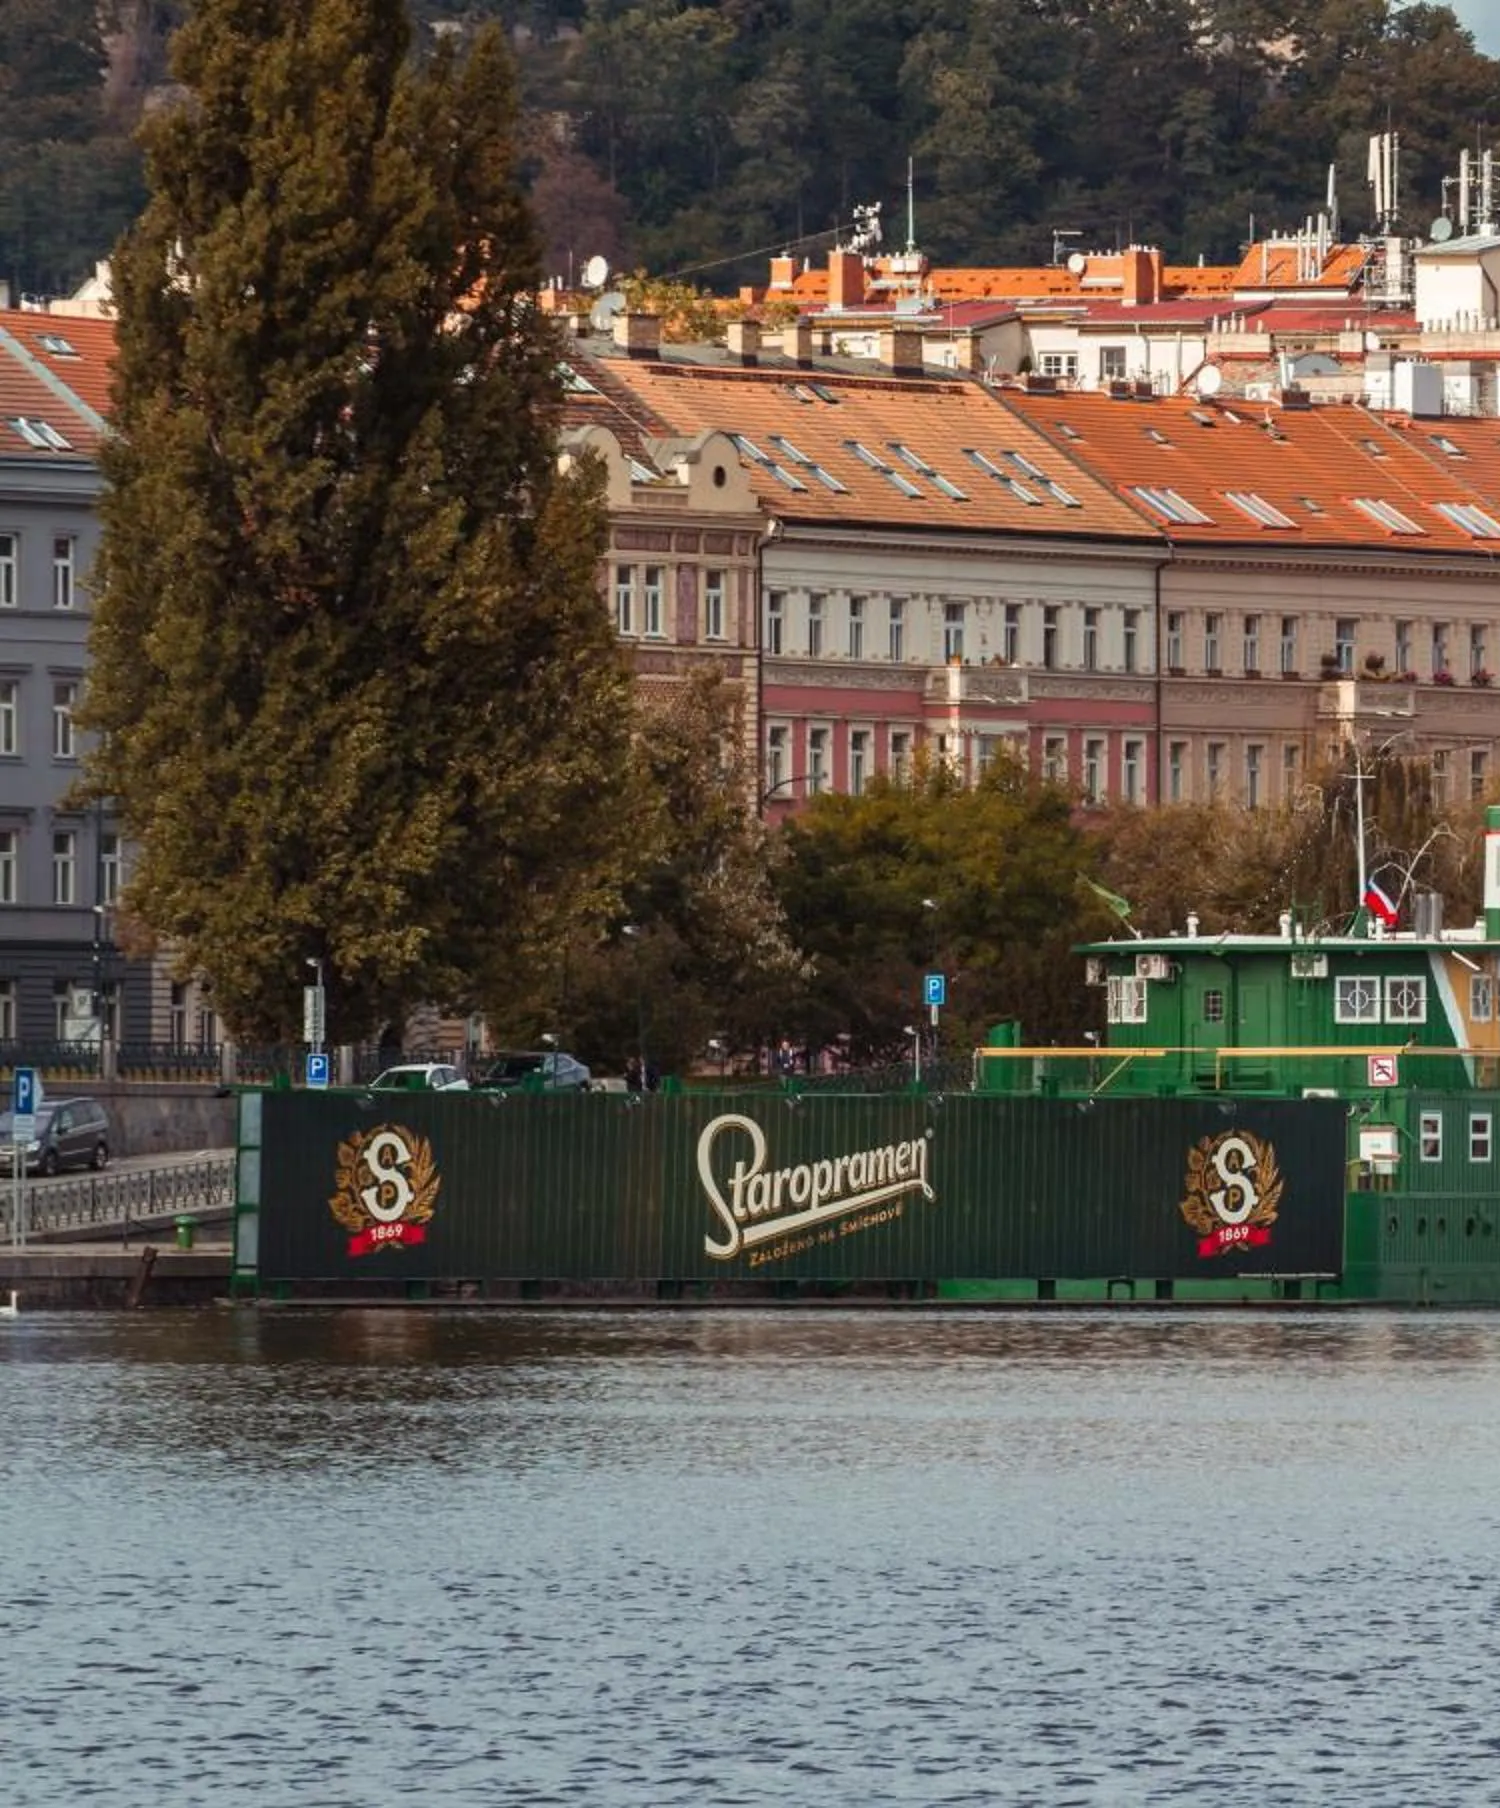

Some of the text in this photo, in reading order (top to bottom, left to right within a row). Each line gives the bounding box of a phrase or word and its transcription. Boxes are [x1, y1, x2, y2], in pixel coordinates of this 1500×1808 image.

[310, 1057, 325, 1077] P
[17, 1075, 31, 1109] P
[370, 1223, 404, 1242] 1869
[1218, 1227, 1250, 1243] 1869
